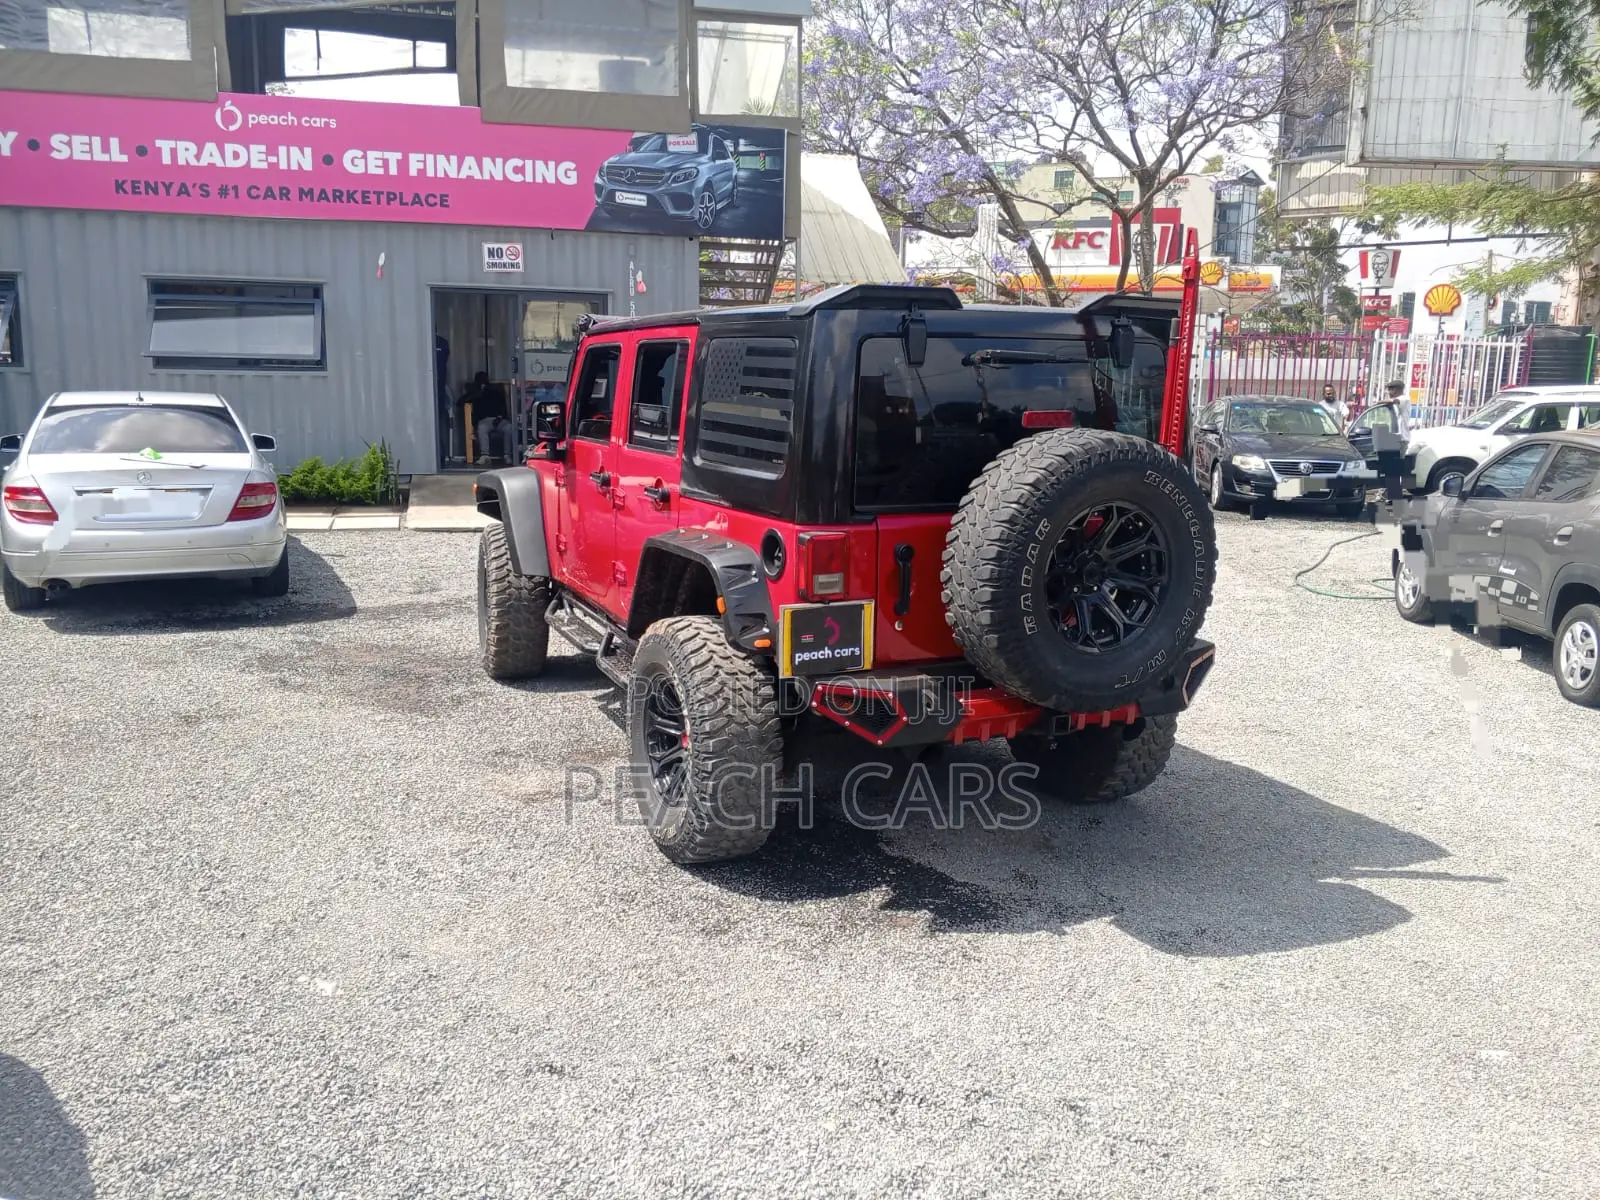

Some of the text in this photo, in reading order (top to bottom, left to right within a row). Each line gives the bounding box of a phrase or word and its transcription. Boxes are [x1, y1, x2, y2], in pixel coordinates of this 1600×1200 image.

[248, 111, 337, 129] peach cars
[50, 133, 129, 163] SELL
[155, 139, 313, 171] TRADE-IN
[342, 148, 402, 176] GET
[409, 152, 578, 185] FINANCING
[114, 179, 450, 208] KENYA'S #1 CAR MARKETPLACE
[1051, 231, 1105, 249] KFC
[487, 246, 504, 259] NO
[486, 261, 521, 270] SMOKING
[1364, 298, 1389, 307] KFC
[1020, 517, 1051, 636] RADAR
[1143, 470, 1205, 599] RENEGADE
[795, 645, 861, 666] peach cars
